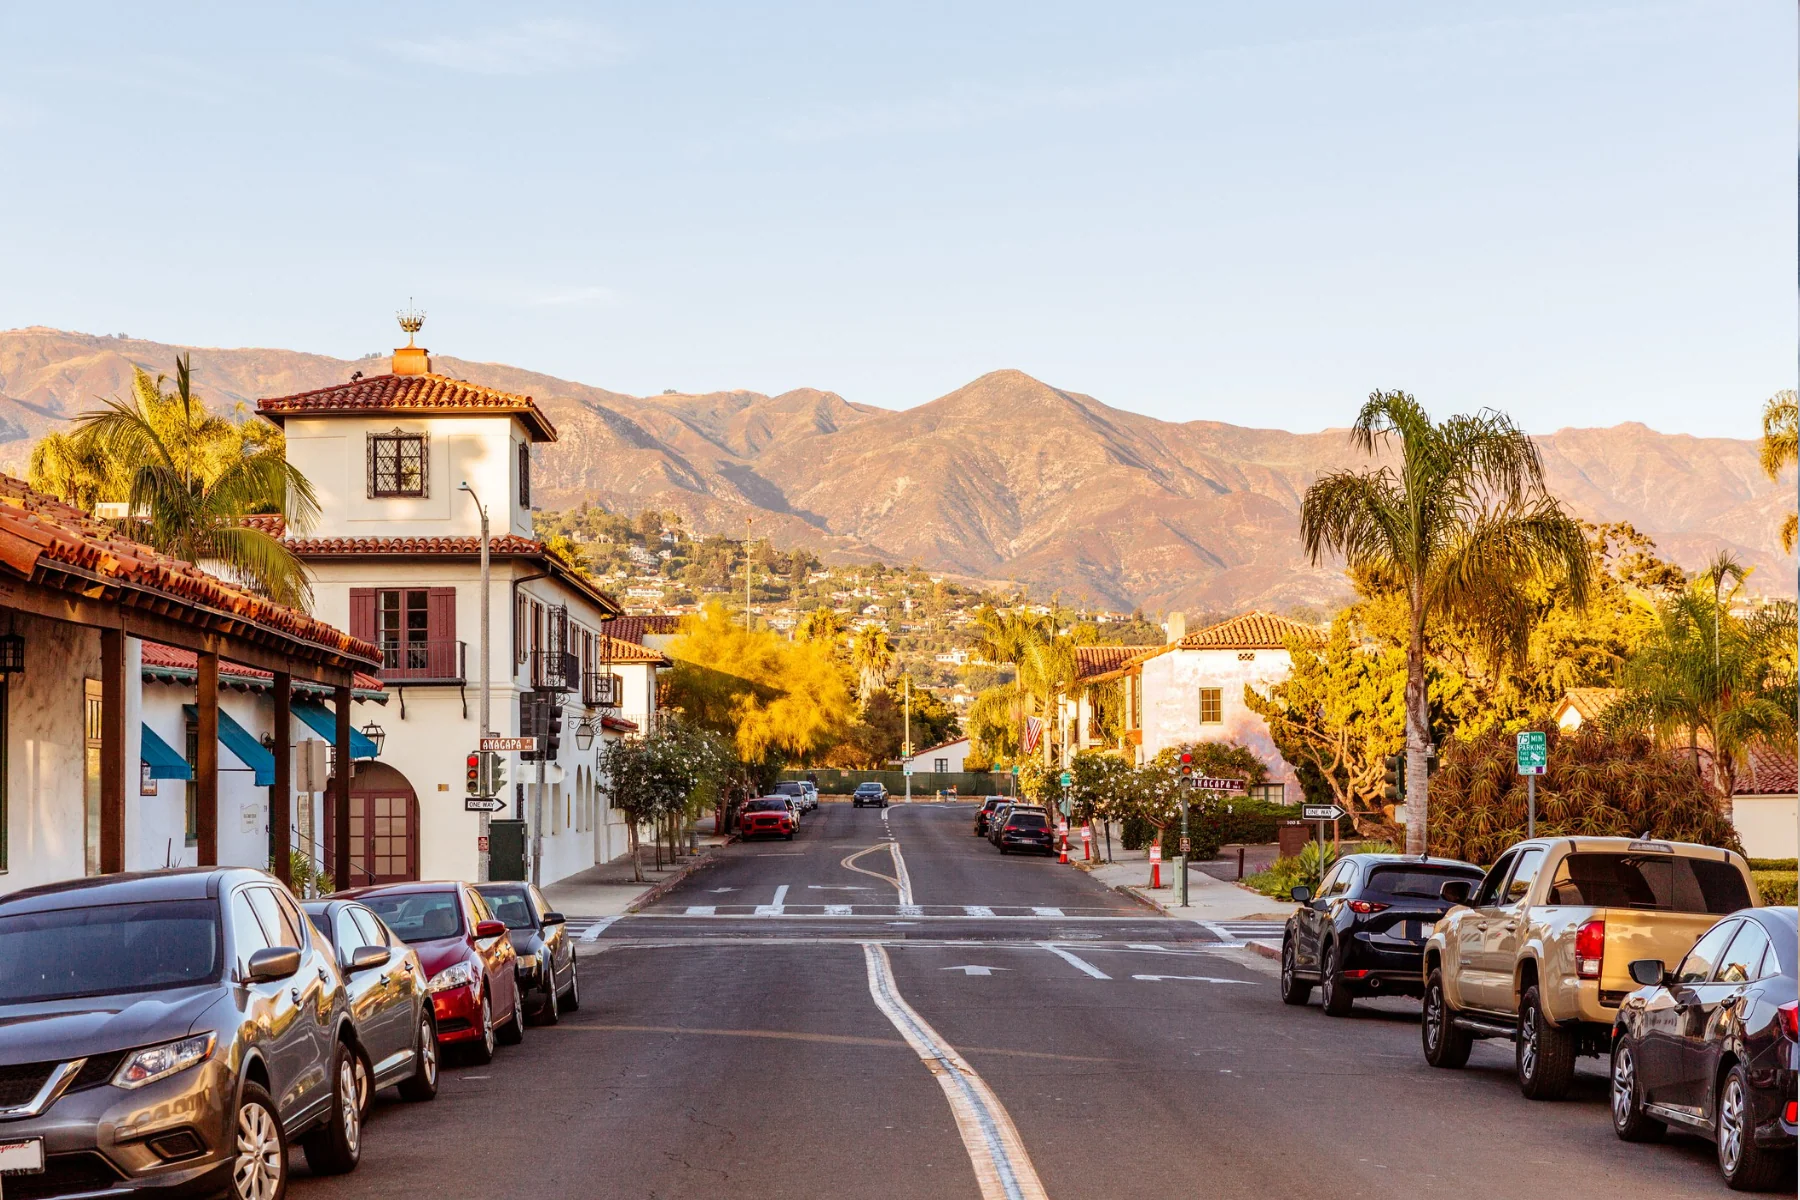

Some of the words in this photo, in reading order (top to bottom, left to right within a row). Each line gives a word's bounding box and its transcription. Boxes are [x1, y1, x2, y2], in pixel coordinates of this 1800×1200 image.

[482, 739, 522, 749] ANACAPA
[1519, 734, 1529, 744] 75
[1531, 735, 1543, 743] MIN
[1191, 779, 1231, 789] ANACAPA
